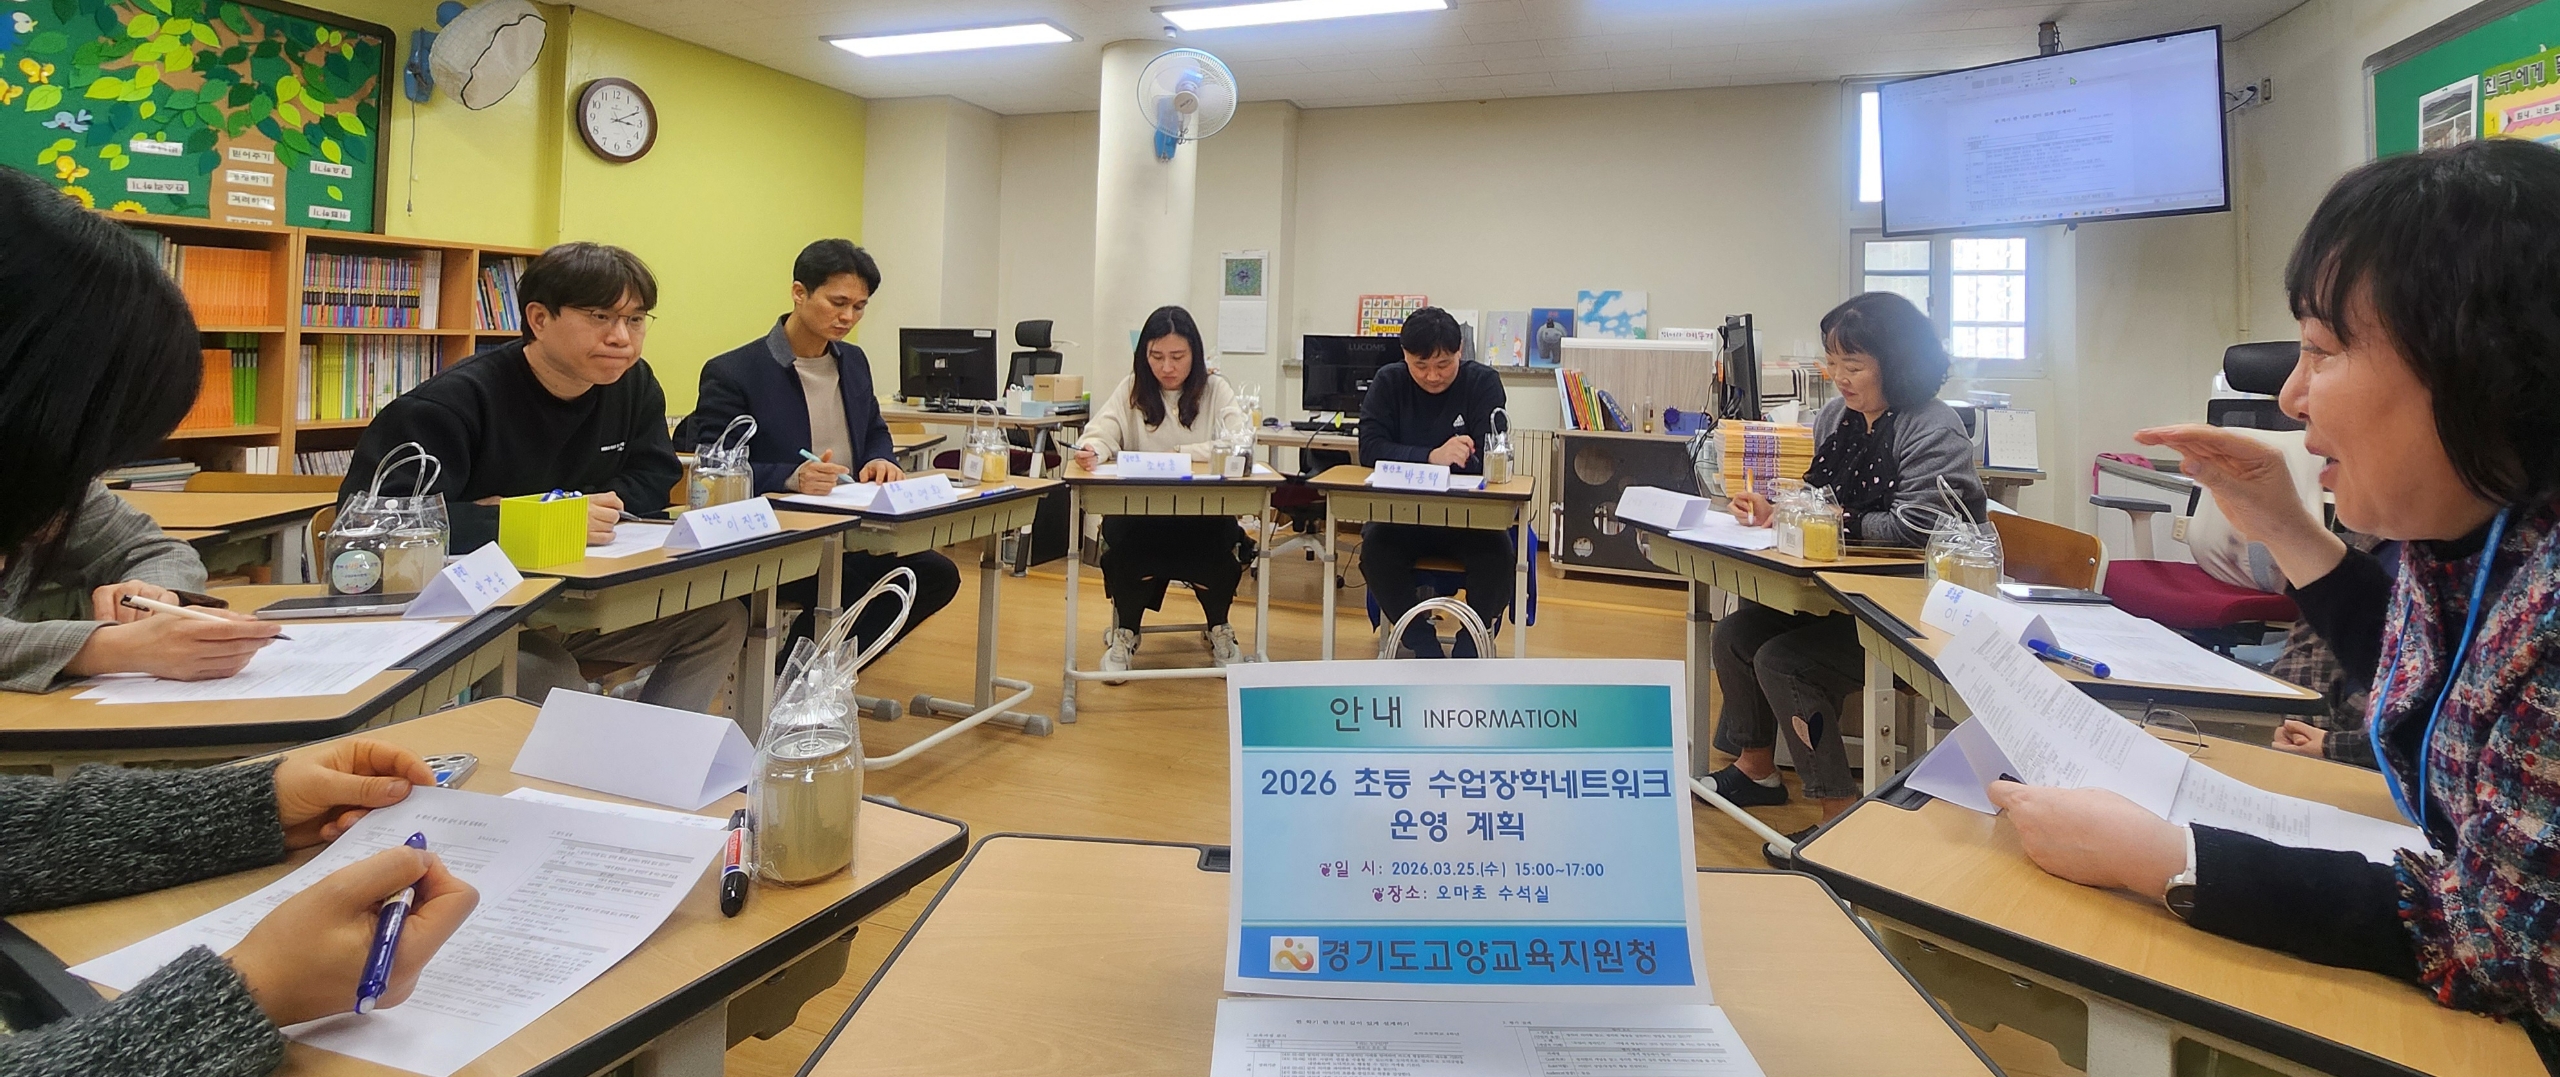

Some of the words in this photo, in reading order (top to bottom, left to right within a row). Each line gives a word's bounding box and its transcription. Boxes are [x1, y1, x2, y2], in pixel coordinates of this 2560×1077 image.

[2484, 60, 2545, 96] 친구에게
[232, 149, 271, 162] 믿어주기
[132, 180, 185, 192] 잔소리하기
[1329, 696, 1403, 732] 안내
[1423, 709, 1578, 729] INFORMATION
[1261, 769, 1337, 796] 2026
[1354, 767, 1412, 799] 초등
[1428, 767, 1673, 800] 수업장학네트워크
[1390, 810, 1448, 843] 운영
[1466, 810, 1525, 842] 계획
[1515, 863, 1605, 878] 15:00~17:00
[1387, 885, 1429, 903] 장소:
[1436, 884, 1488, 902] 오마초
[1498, 884, 1551, 904] 수석실
[1321, 938, 1658, 975] 경기도고양교육지원청
